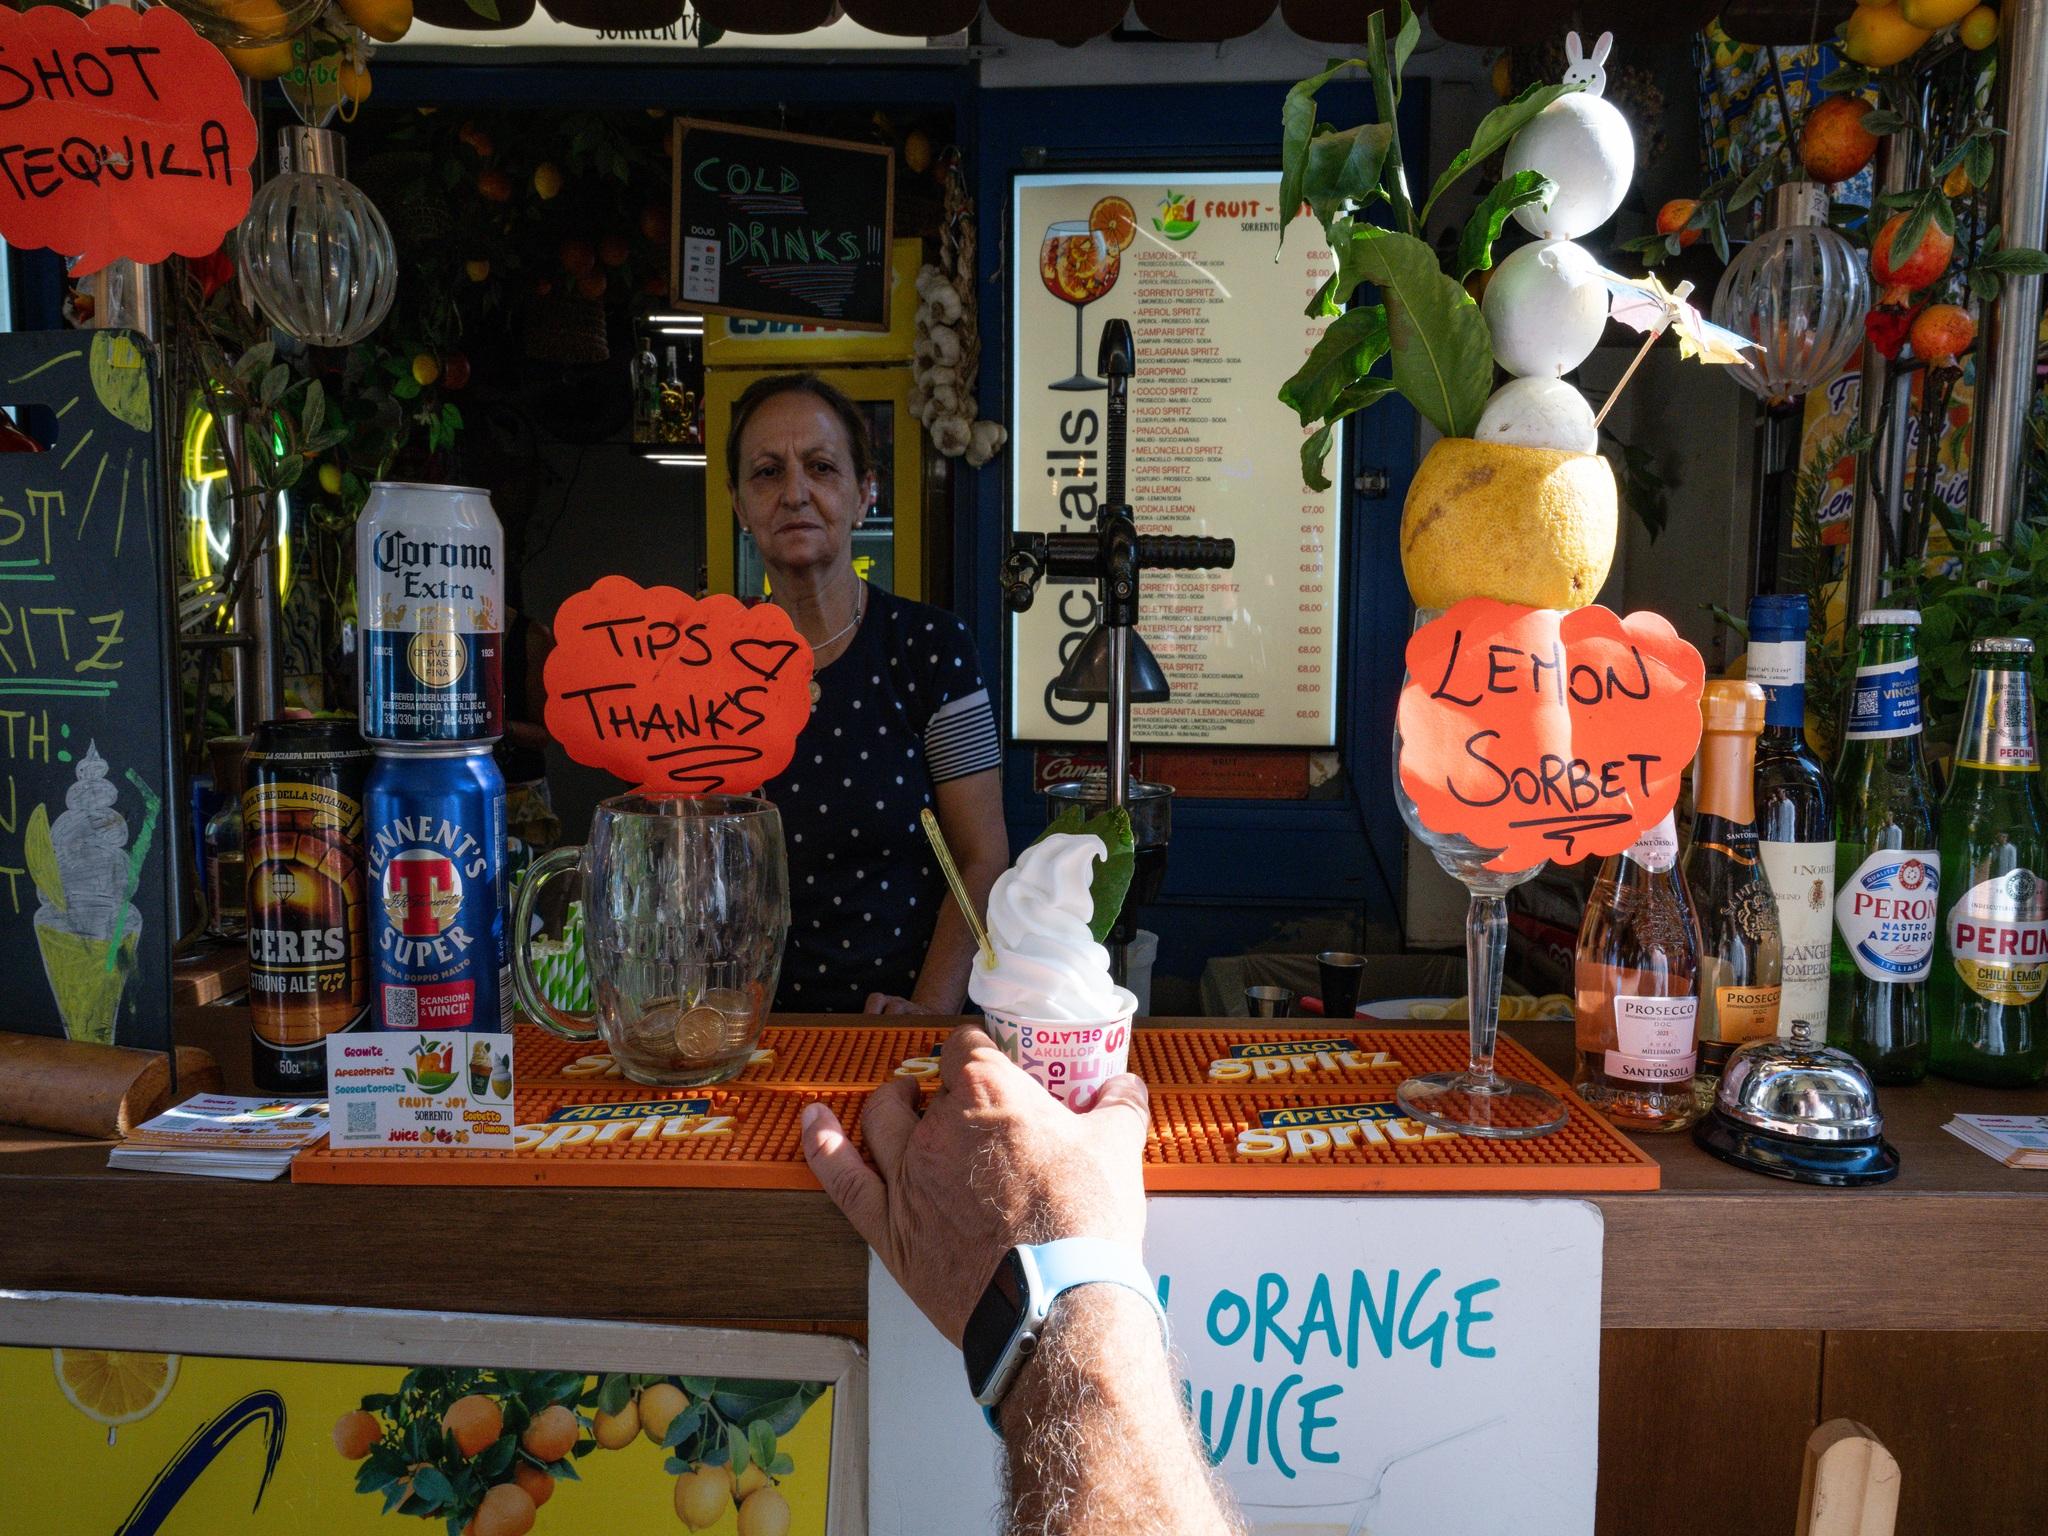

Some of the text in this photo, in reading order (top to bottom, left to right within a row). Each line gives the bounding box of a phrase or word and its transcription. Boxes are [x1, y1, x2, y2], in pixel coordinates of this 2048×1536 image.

[694, 157, 799, 195] COLD
[1204, 200, 1260, 218] FRUIT
[691, 225, 716, 237] DOJO
[1240, 222, 1280, 232] SORRENTO
[1137, 288, 1215, 297] SORRENTO SPRITZ
[1137, 308, 1201, 316] APEROL SPRITZ
[1137, 327, 1206, 336] CAMPARI SPRITZ
[1137, 347, 1220, 356] MELAGRANA SPRITZ
[1137, 367, 1186, 376] SGROPPINO
[1136, 387, 1199, 396] COCCO SPRITZ
[1136, 407, 1192, 416] HUGO SPRITZ
[1136, 427, 1190, 435] PINACOLADA
[1135, 446, 1223, 455] MELONCELLO SPRITZ
[1135, 466, 1191, 475] CAPRI SPRITZ
[1135, 485, 1181, 494] GIN LEMON
[1135, 504, 1196, 513] VODKA LEMON
[1135, 524, 1173, 533] NEGRONI
[373, 529, 493, 578] Corona
[1044, 408, 1099, 726] Cocails
[403, 571, 474, 600] Extra
[1138, 583, 1180, 592] ORRENTO
[1211, 583, 1240, 592] SPRITZ
[1139, 605, 1204, 613] IOLETTE SPRITZ
[1193, 624, 1222, 633] SPRITZ
[430, 639, 444, 648] LA
[582, 615, 712, 667] TIPS
[413, 649, 462, 658] CERVEZA
[427, 659, 449, 668] MAS
[1176, 663, 1204, 671] SPRITZ
[1429, 628, 1651, 708] LEMON
[426, 669, 450, 677] FINA
[1170, 682, 1199, 690] SPRITZ
[1133, 708, 1161, 716] SLUSH
[1161, 708, 1197, 716] GRANITA
[1999, 748, 2033, 759] PERONI
[1446, 728, 1662, 815] SORBET
[277, 790, 353, 816] DELLA SQUADRA
[367, 815, 487, 882] TENNENT'S
[1882, 922, 1927, 932] NASTRO
[1868, 930, 1933, 943] AZZURRO
[249, 927, 346, 964] CERES
[379, 925, 475, 968] SUPER
[403, 972, 439, 983] DOPPIO
[440, 957, 472, 979] MALTO
[1880, 960, 1923, 973] ITALIANA
[1977, 967, 2042, 982] CHILL LEMON
[250, 975, 287, 994] STRONG
[289, 974, 317, 993] ALE
[420, 992, 471, 1006] SCANSIONA
[1624, 1002, 1695, 1017] PROSECCO
[1036, 1028, 1103, 1045] GELATO
[344, 1046, 383, 1058] Granite
[1241, 1039, 1353, 1058] APEROL
[1209, 1048, 1400, 1081] Spritz
[398, 1096, 467, 1109] FRUIT JOY
[414, 1110, 453, 1121] SORRENTO
[463, 1109, 502, 1123] Sorbetto
[560, 1101, 708, 1123] APEROL
[1273, 1105, 1394, 1126] APEROL
[387, 1128, 419, 1143] juice
[513, 1114, 736, 1153] Spritz
[1236, 1111, 1460, 1159] Spritz
[1206, 1267, 1502, 1370] ORANGE
[1184, 1374, 1345, 1481] UICE
